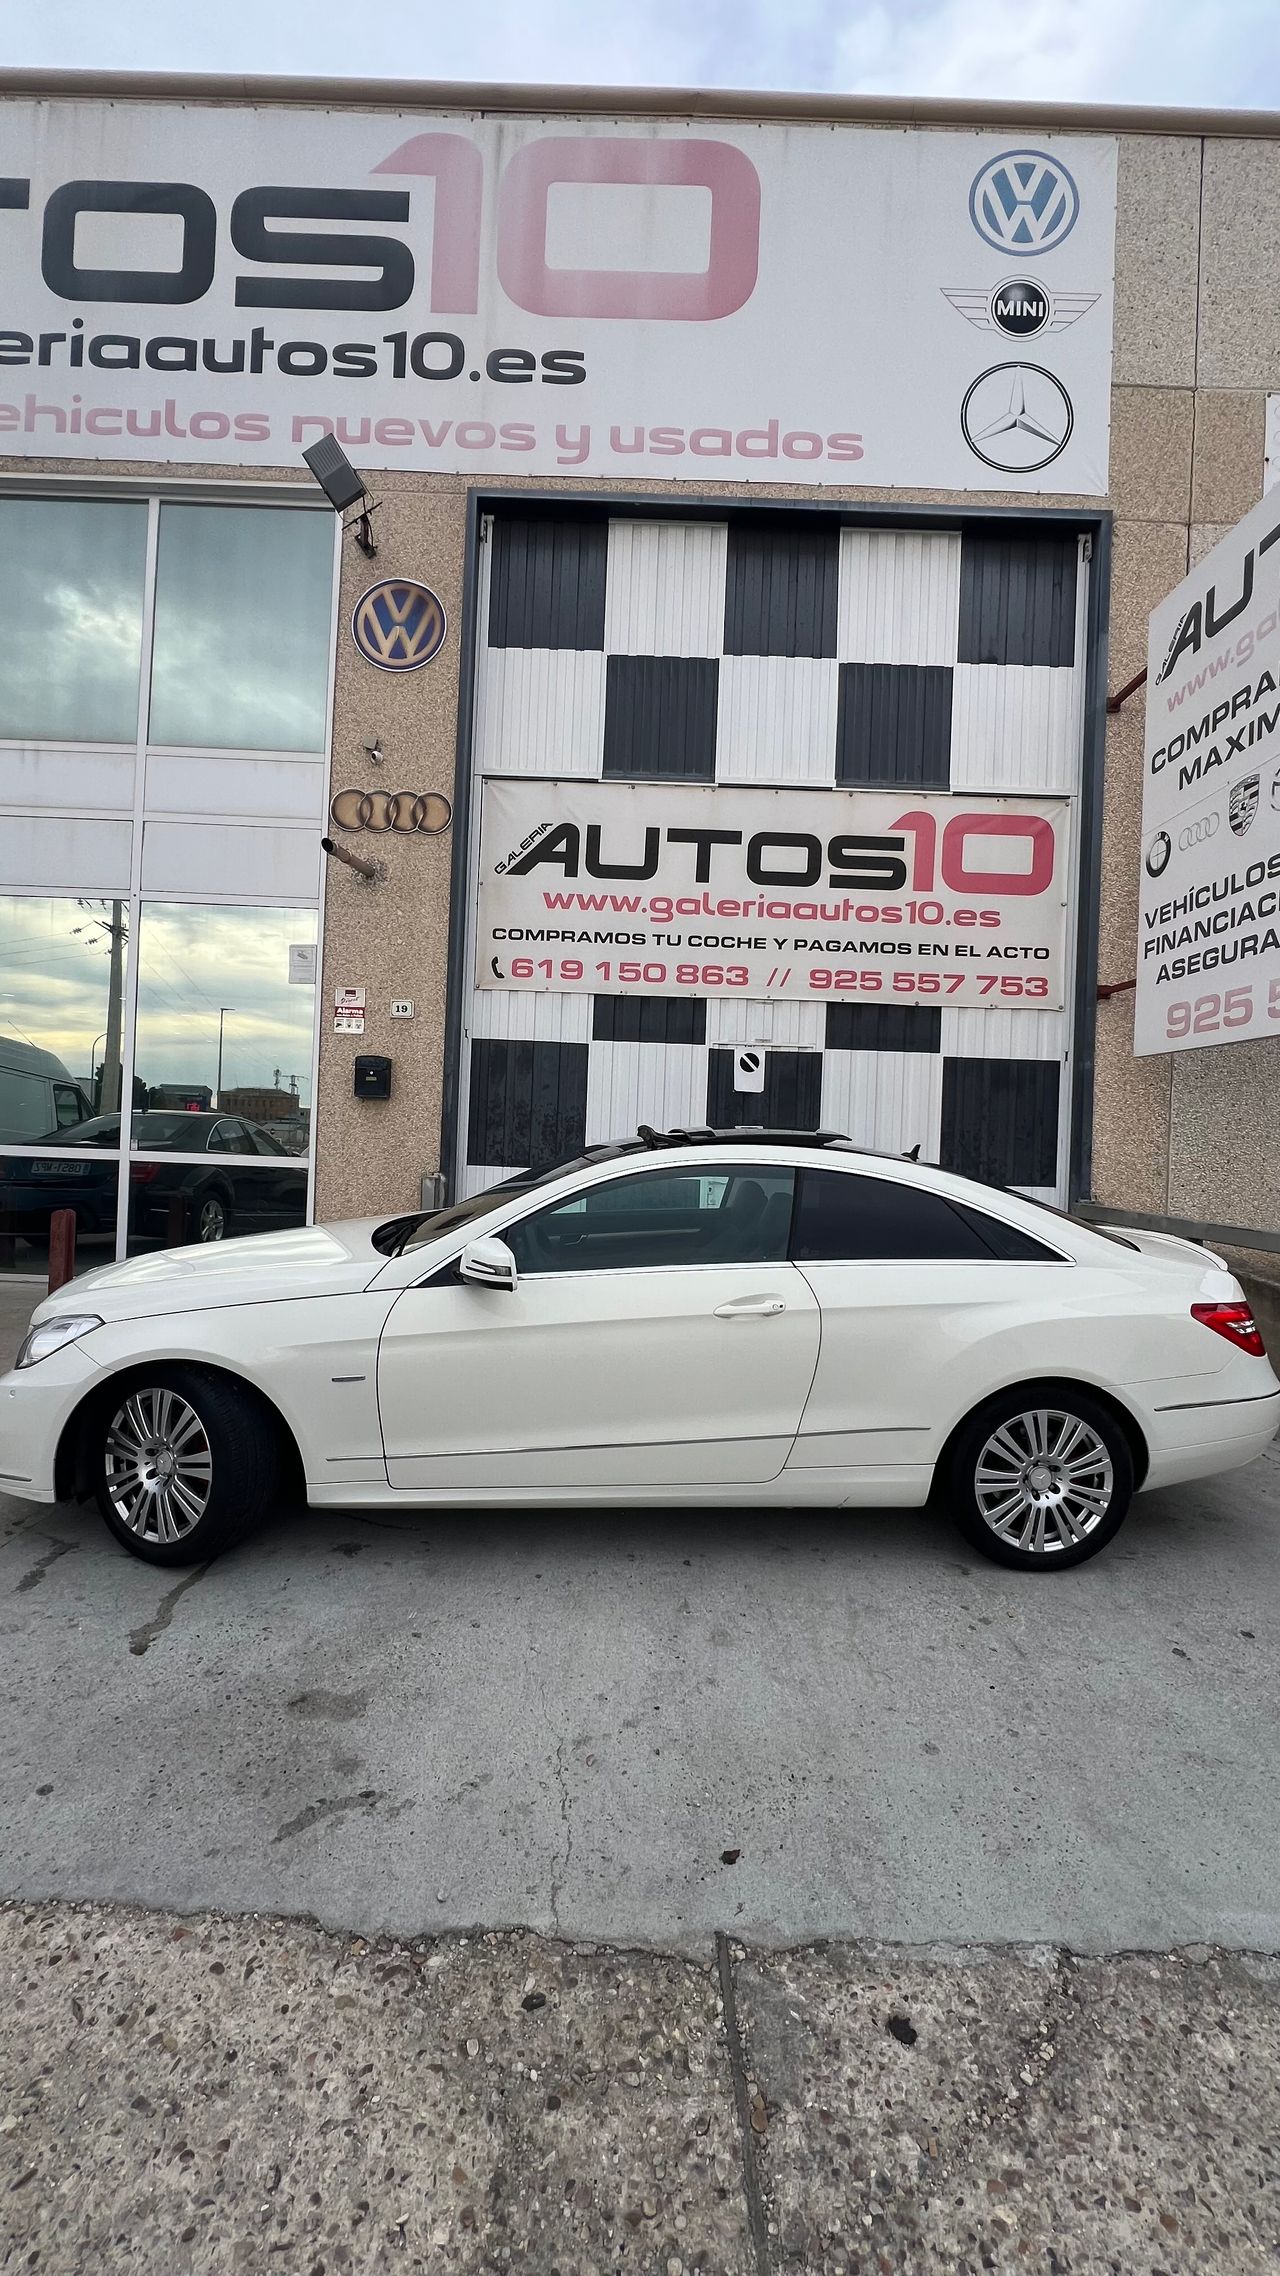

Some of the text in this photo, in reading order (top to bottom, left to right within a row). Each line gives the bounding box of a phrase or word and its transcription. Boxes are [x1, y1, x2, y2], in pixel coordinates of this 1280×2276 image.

[0, 132, 762, 322] OS10
[997, 299, 1044, 317] MINI
[291, 415, 538, 452] nuevos
[556, 424, 591, 465] y
[609, 419, 866, 462] usados
[1167, 605, 1280, 713] www.ga
[1151, 668, 1280, 775] COMPRA
[493, 822, 554, 875] GALERIA
[505, 809, 1057, 898] AUTOS10
[542, 889, 1002, 929] www.galeriaautos10.es
[1144, 853, 1280, 929] VEHÍCULOS
[491, 927, 1051, 960] COMPRAMOS TU COCHE Y PAGAMOS EN EL ACTO
[1144, 893, 1280, 960] FINANCIAC
[510, 956, 585, 983] 619
[595, 960, 668, 985] 150
[674, 963, 751, 988] 863
[807, 966, 884, 993] 925
[892, 970, 967, 997] 557
[974, 974, 1051, 1000] 753
[1155, 928, 1280, 985] ASEGURA
[395, 1004, 408, 1013] 19
[1166, 984, 1254, 1040] 925
